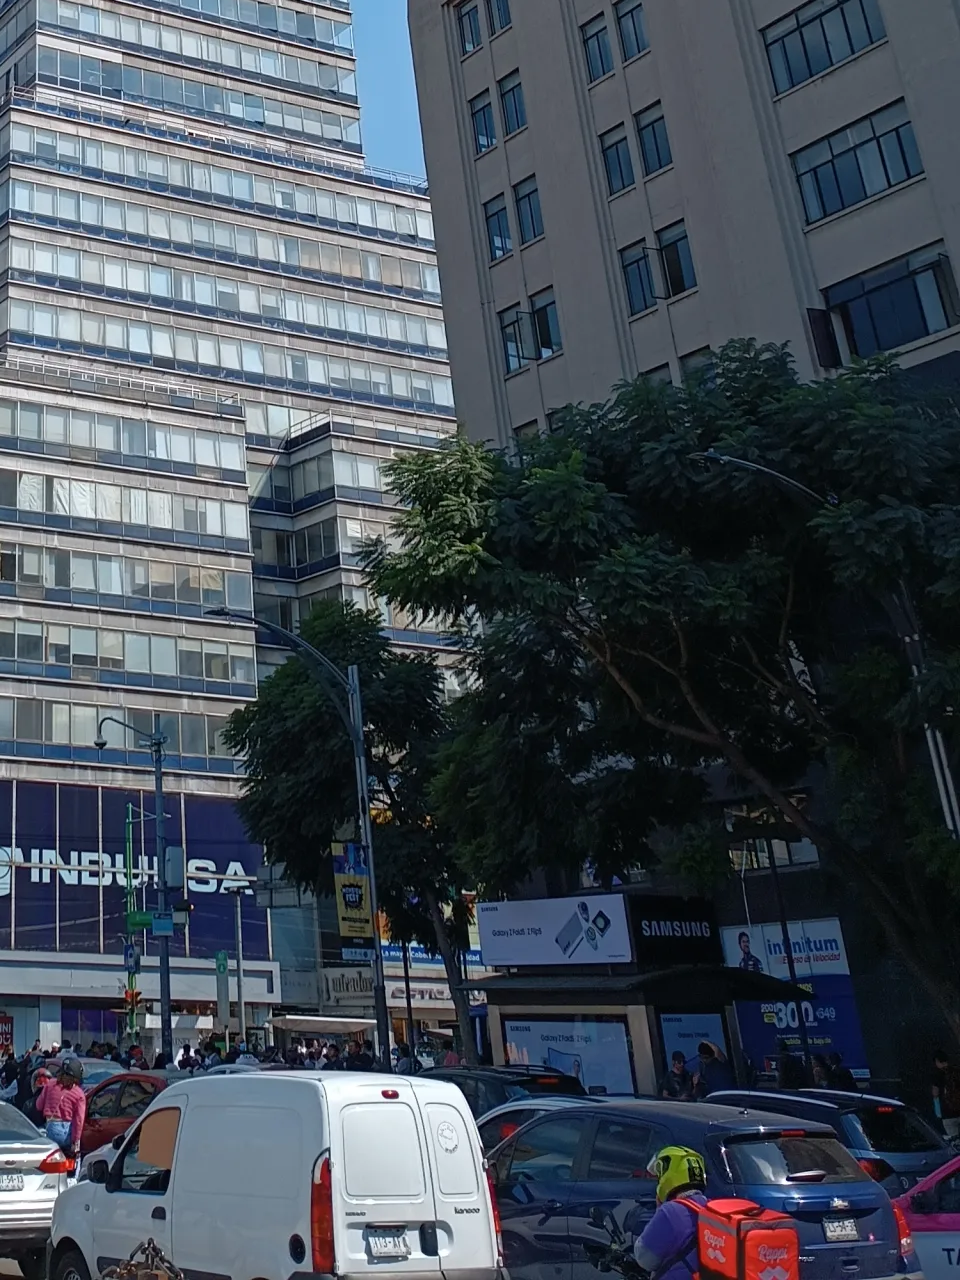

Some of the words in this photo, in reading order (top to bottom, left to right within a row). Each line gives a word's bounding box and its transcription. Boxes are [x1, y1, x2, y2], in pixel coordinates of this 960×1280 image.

[31, 848, 254, 896] INBUSA
[641, 920, 711, 937] SAMSUNG
[704, 1229, 726, 1248] Rappi
[758, 1243, 789, 1264] Rappi
